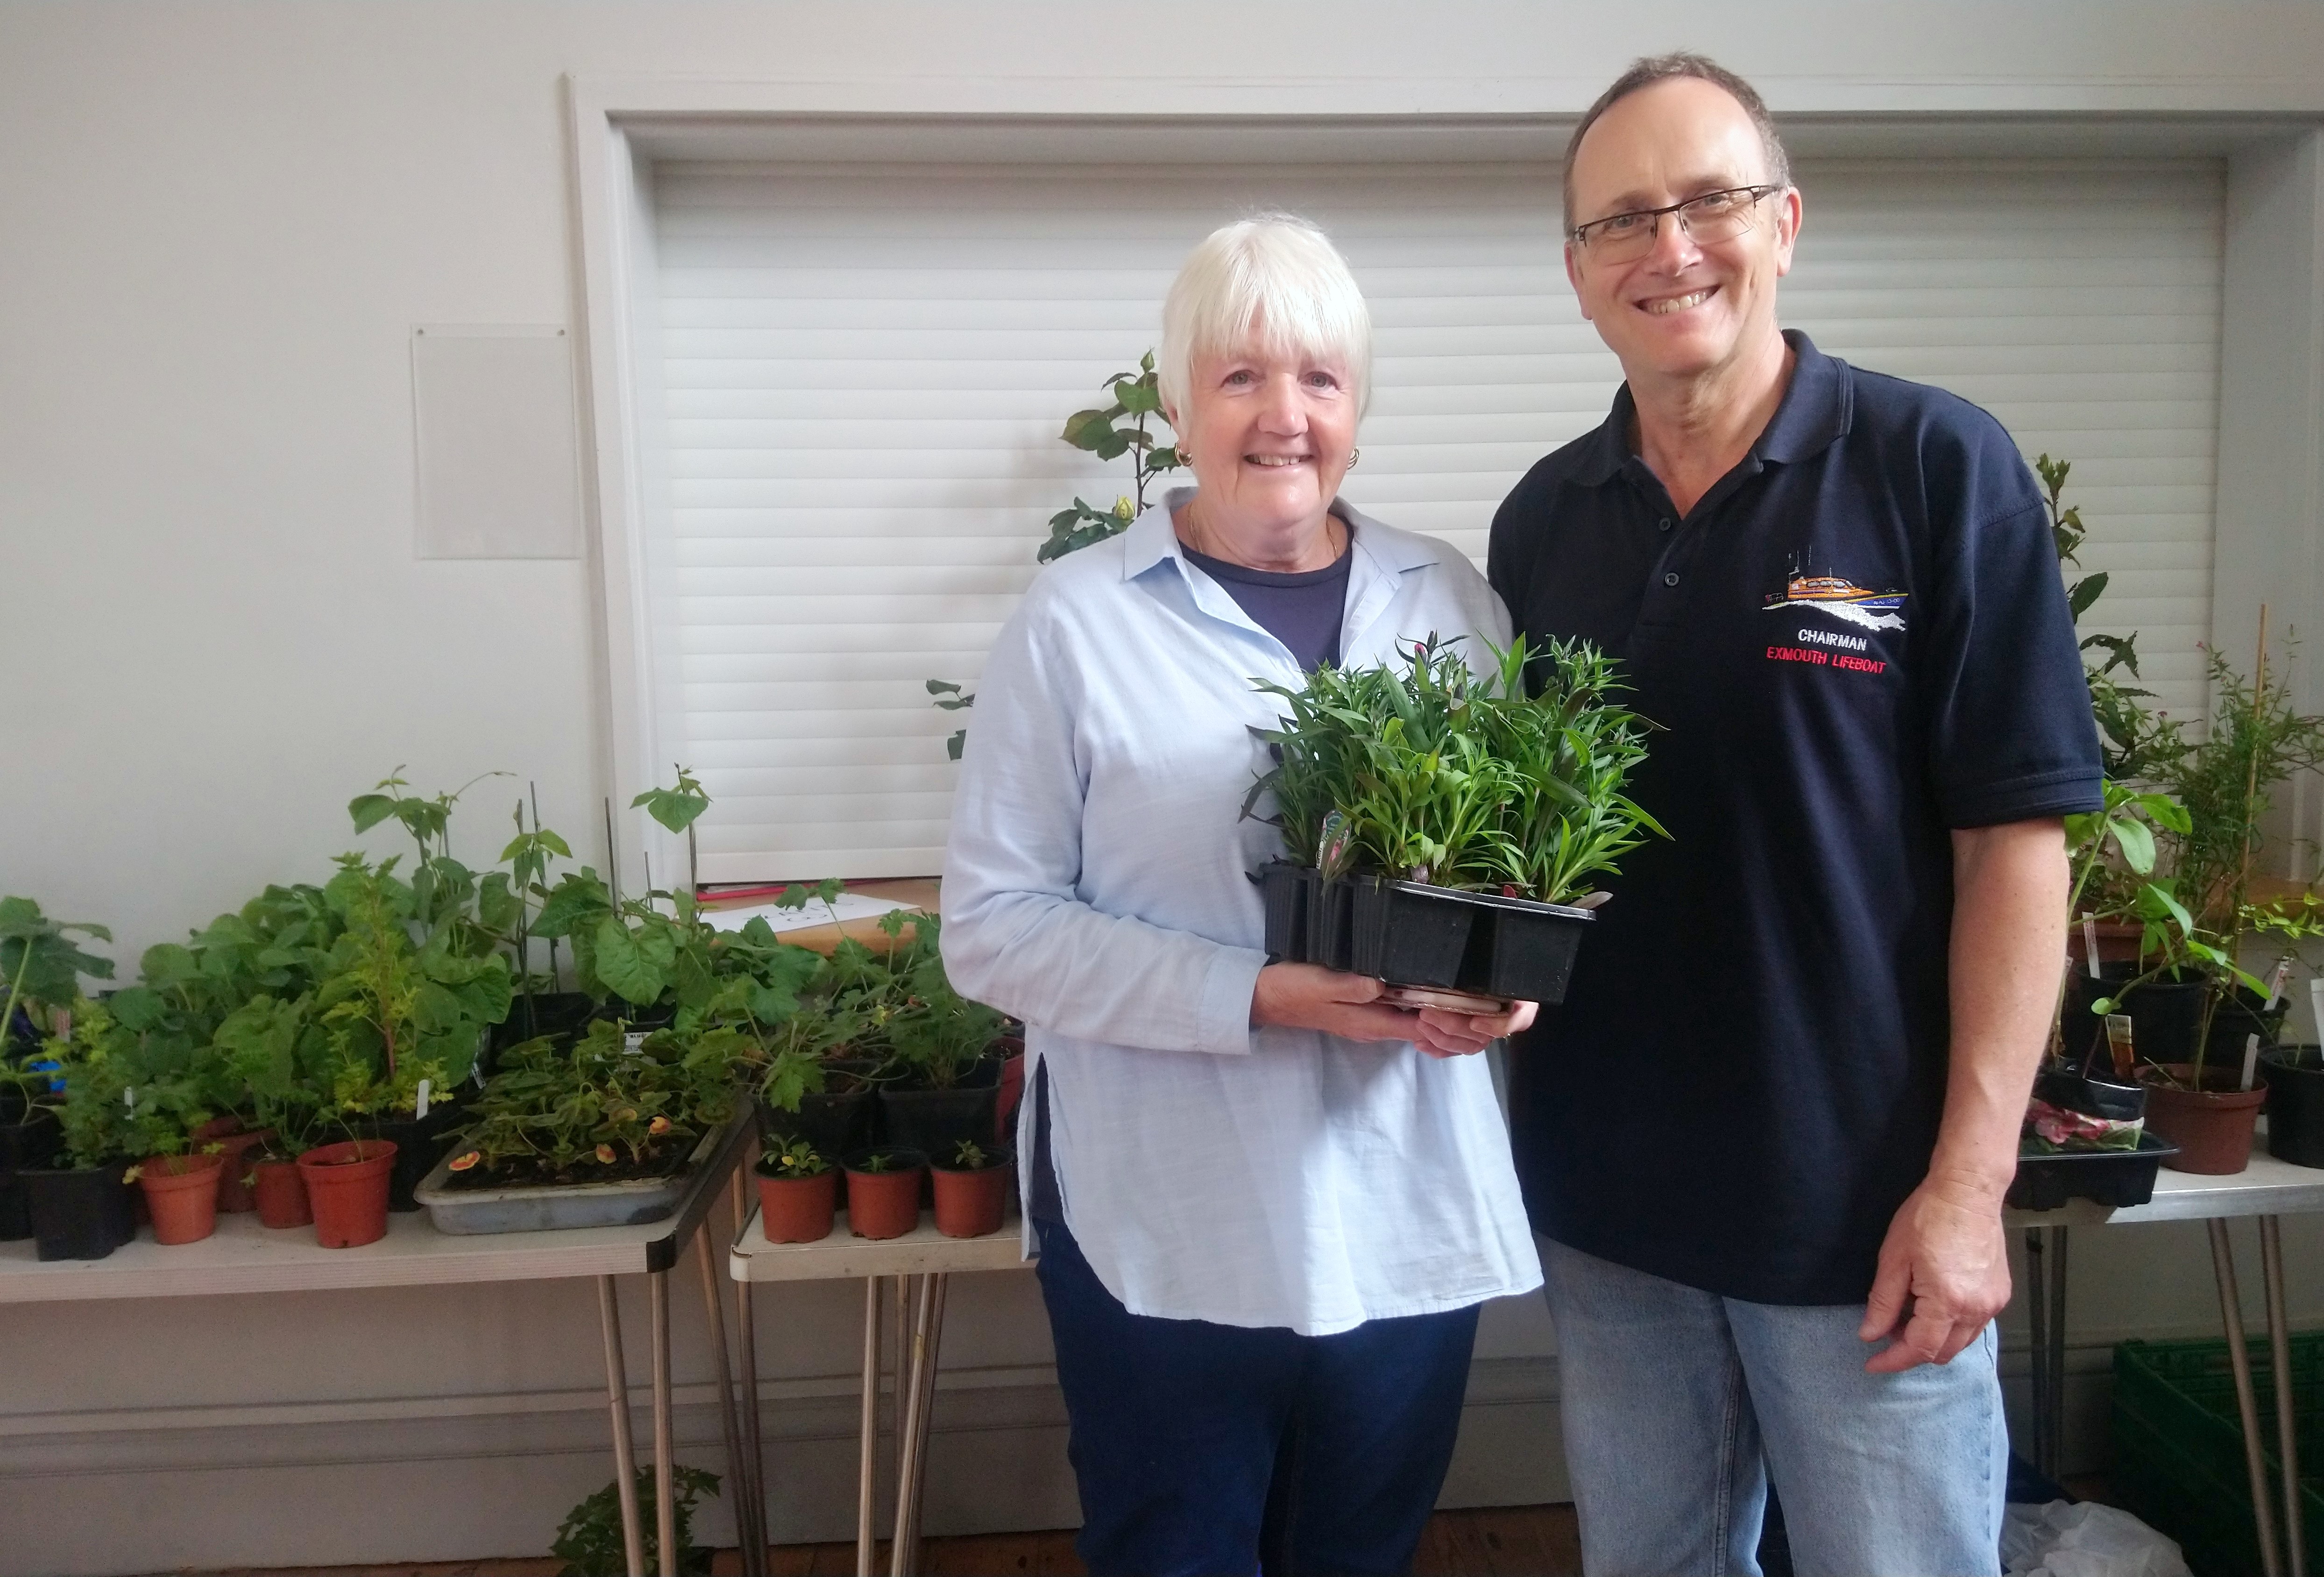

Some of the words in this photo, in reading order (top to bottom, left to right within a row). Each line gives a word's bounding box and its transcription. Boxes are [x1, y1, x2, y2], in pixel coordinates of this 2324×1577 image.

[1798, 629, 1867, 651] CHAIRMAN
[1766, 646, 1828, 665] EXMOUTH
[1832, 654, 1887, 674] LIFEBOAT
